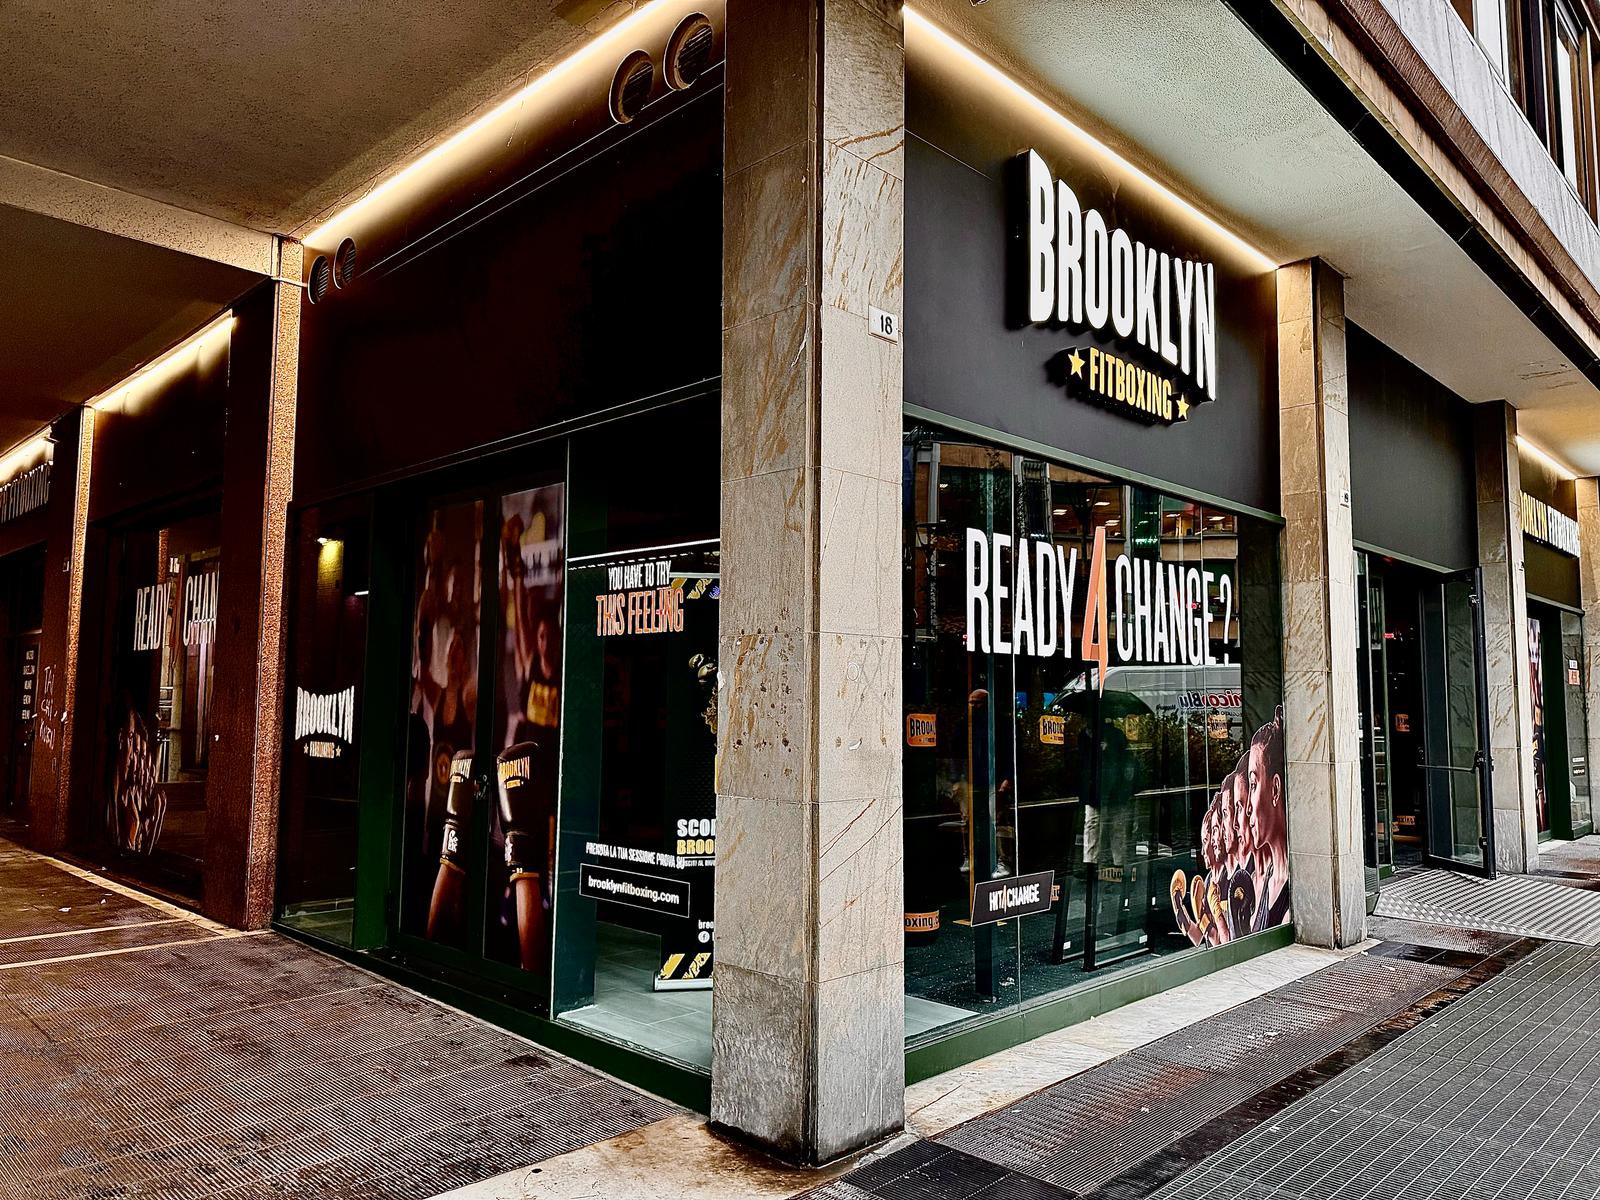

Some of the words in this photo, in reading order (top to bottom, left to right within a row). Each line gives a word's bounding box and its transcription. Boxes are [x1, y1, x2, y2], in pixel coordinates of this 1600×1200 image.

[1030, 149, 1215, 401] BROOKLYN
[880, 314, 893, 335] 18
[1089, 347, 1172, 420] FITBOXING
[608, 566, 623, 591] YOU
[624, 563, 643, 589] HAVE
[645, 562, 655, 587] TO
[656, 560, 671, 586] TRY
[966, 527, 1077, 658] READY
[134, 583, 171, 652] READY
[596, 593, 626, 637] THIS
[627, 587, 684, 635] FEELING
[295, 685, 355, 744] BROOKLYN
[610, 845, 617, 858] LA
[617, 847, 628, 860] TUA
[588, 875, 680, 905] brooklynfitboxing.com
